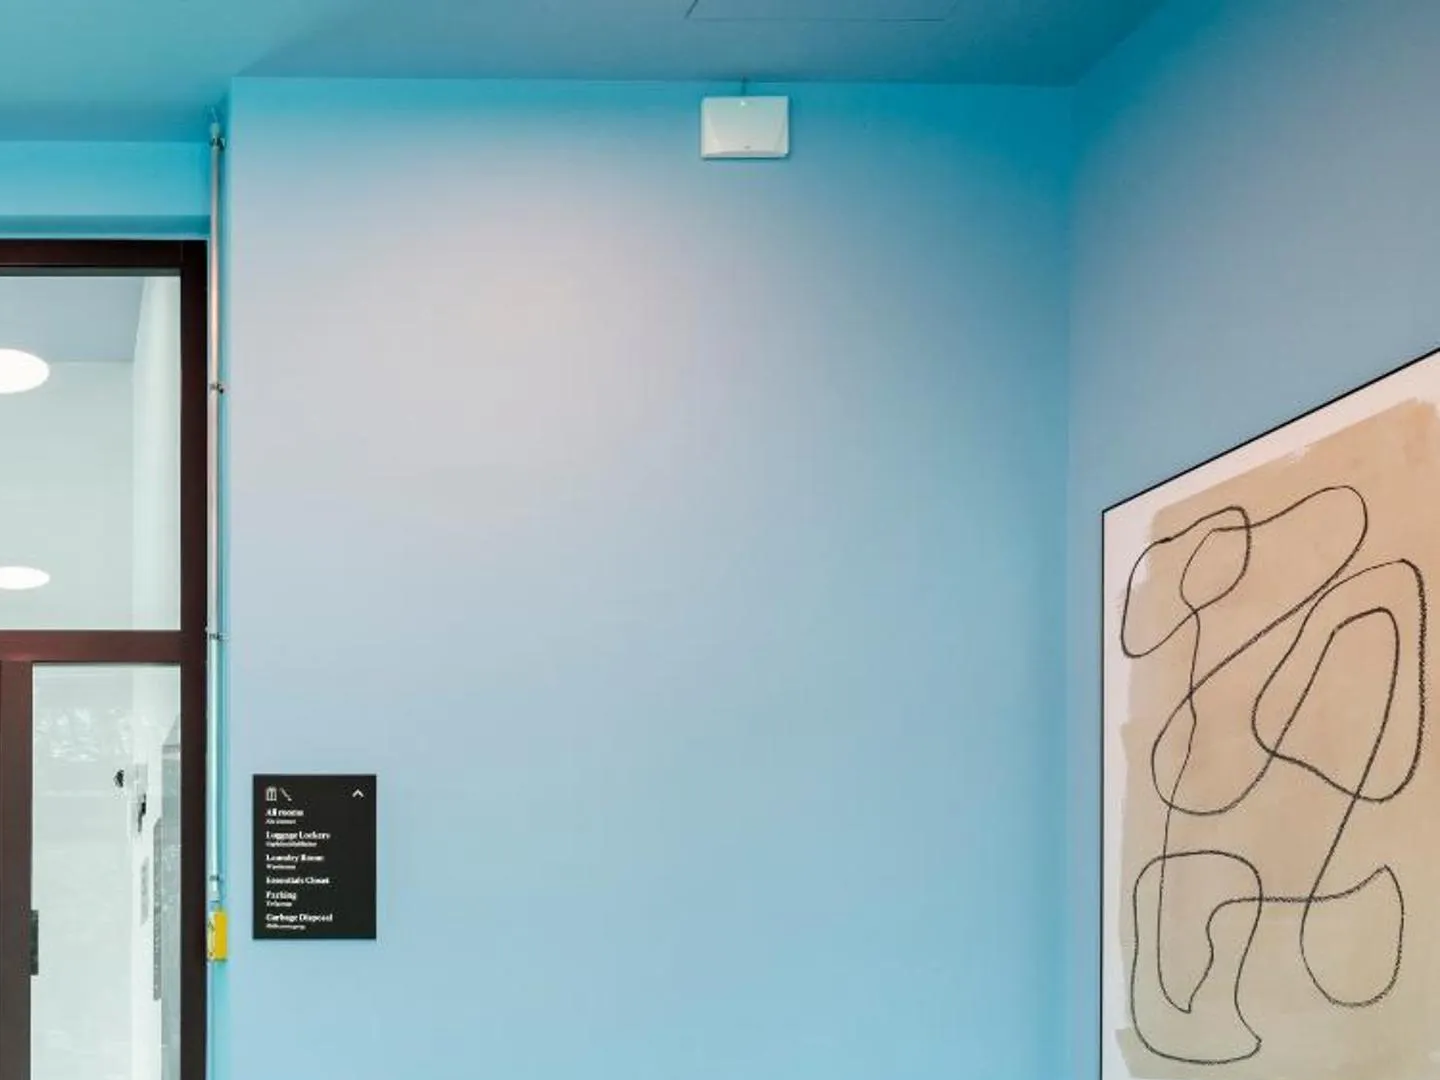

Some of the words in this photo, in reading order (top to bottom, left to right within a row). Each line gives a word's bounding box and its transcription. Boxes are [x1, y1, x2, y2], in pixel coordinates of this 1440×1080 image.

[299, 831, 331, 839] Lockers
[266, 891, 297, 901] Parking
[266, 913, 298, 922] Garbage
[299, 913, 334, 922] Disposal
